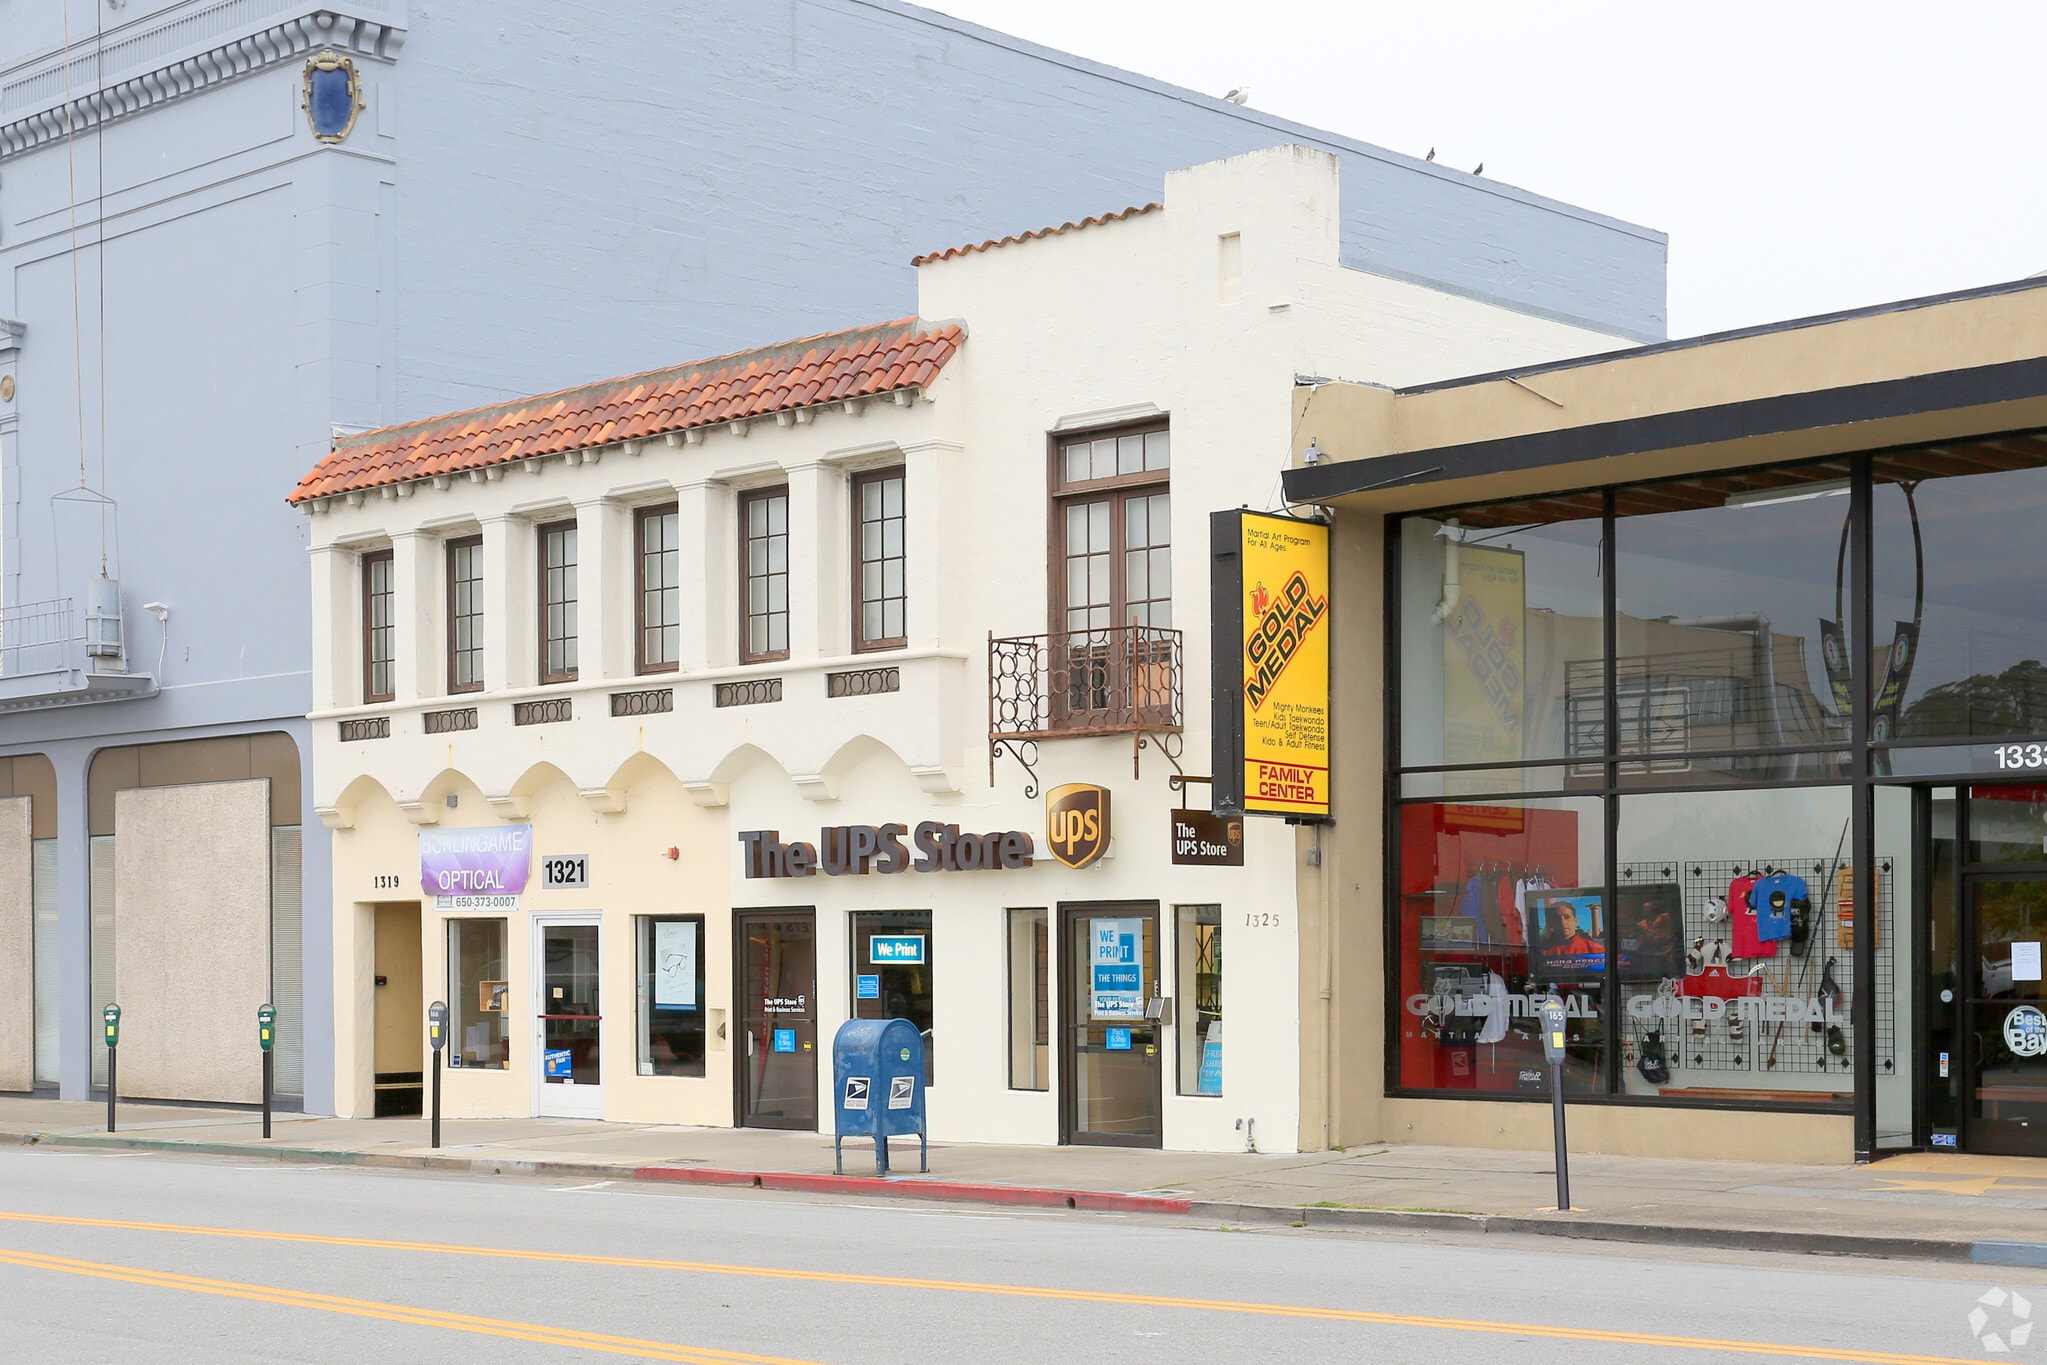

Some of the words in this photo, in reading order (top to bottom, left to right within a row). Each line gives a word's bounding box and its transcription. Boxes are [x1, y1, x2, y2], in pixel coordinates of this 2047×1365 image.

[1248, 529, 1269, 539] Martial
[1272, 533, 1281, 541] Art
[1284, 535, 1310, 546] Program
[1248, 538, 1256, 546] For
[1270, 543, 1286, 552] Ages
[1248, 576, 1306, 664] GOLD
[1247, 598, 1324, 706] MEDAL
[1273, 702, 1294, 713] Mighty
[1296, 704, 1324, 714] Monkees
[1274, 712, 1286, 722] Kids
[1290, 714, 1324, 725] Taekwondo
[1290, 722, 1324, 734] Taekwondo
[1286, 730, 1296, 739] Self
[1299, 732, 1324, 742] Defense
[1278, 738, 1283, 746] &
[1286, 740, 1302, 748] Adult
[1304, 741, 1324, 750] Fitness
[1994, 744, 2047, 769] 133
[1260, 765, 1314, 784] FAMILY
[1260, 782, 1314, 800] CENTER
[1051, 809, 1098, 856] ups
[1176, 822, 1196, 838] The
[1230, 830, 1240, 842] ups
[422, 832, 522, 854] BURLINGAME
[738, 830, 816, 879] The
[820, 823, 909, 876] UPS
[914, 820, 1034, 873] Store
[1176, 840, 1198, 856] UPS
[1200, 841, 1227, 856] Store
[545, 860, 584, 884] 1321
[374, 875, 399, 888] 1319
[438, 870, 504, 890] OPTICAL
[456, 897, 516, 907] 650-373-0007
[1246, 913, 1280, 928] 1325
[1100, 930, 1114, 942] WE
[878, 942, 893, 956] We
[895, 942, 918, 956] Print
[1100, 946, 1128, 958] PRINT
[1098, 974, 1110, 982] THE
[1112, 974, 1136, 982] THINGS
[1106, 1000, 1118, 1009] UPS
[1406, 994, 1495, 1018] GOLD
[1626, 994, 1726, 1020] GOLD
[1738, 996, 1844, 1022] MEDAL
[1550, 1012, 1563, 1020] 165
[2014, 1011, 2047, 1026] Best
[1522, 1033, 1580, 1041] ARS
[2010, 1029, 2047, 1054] Bay
